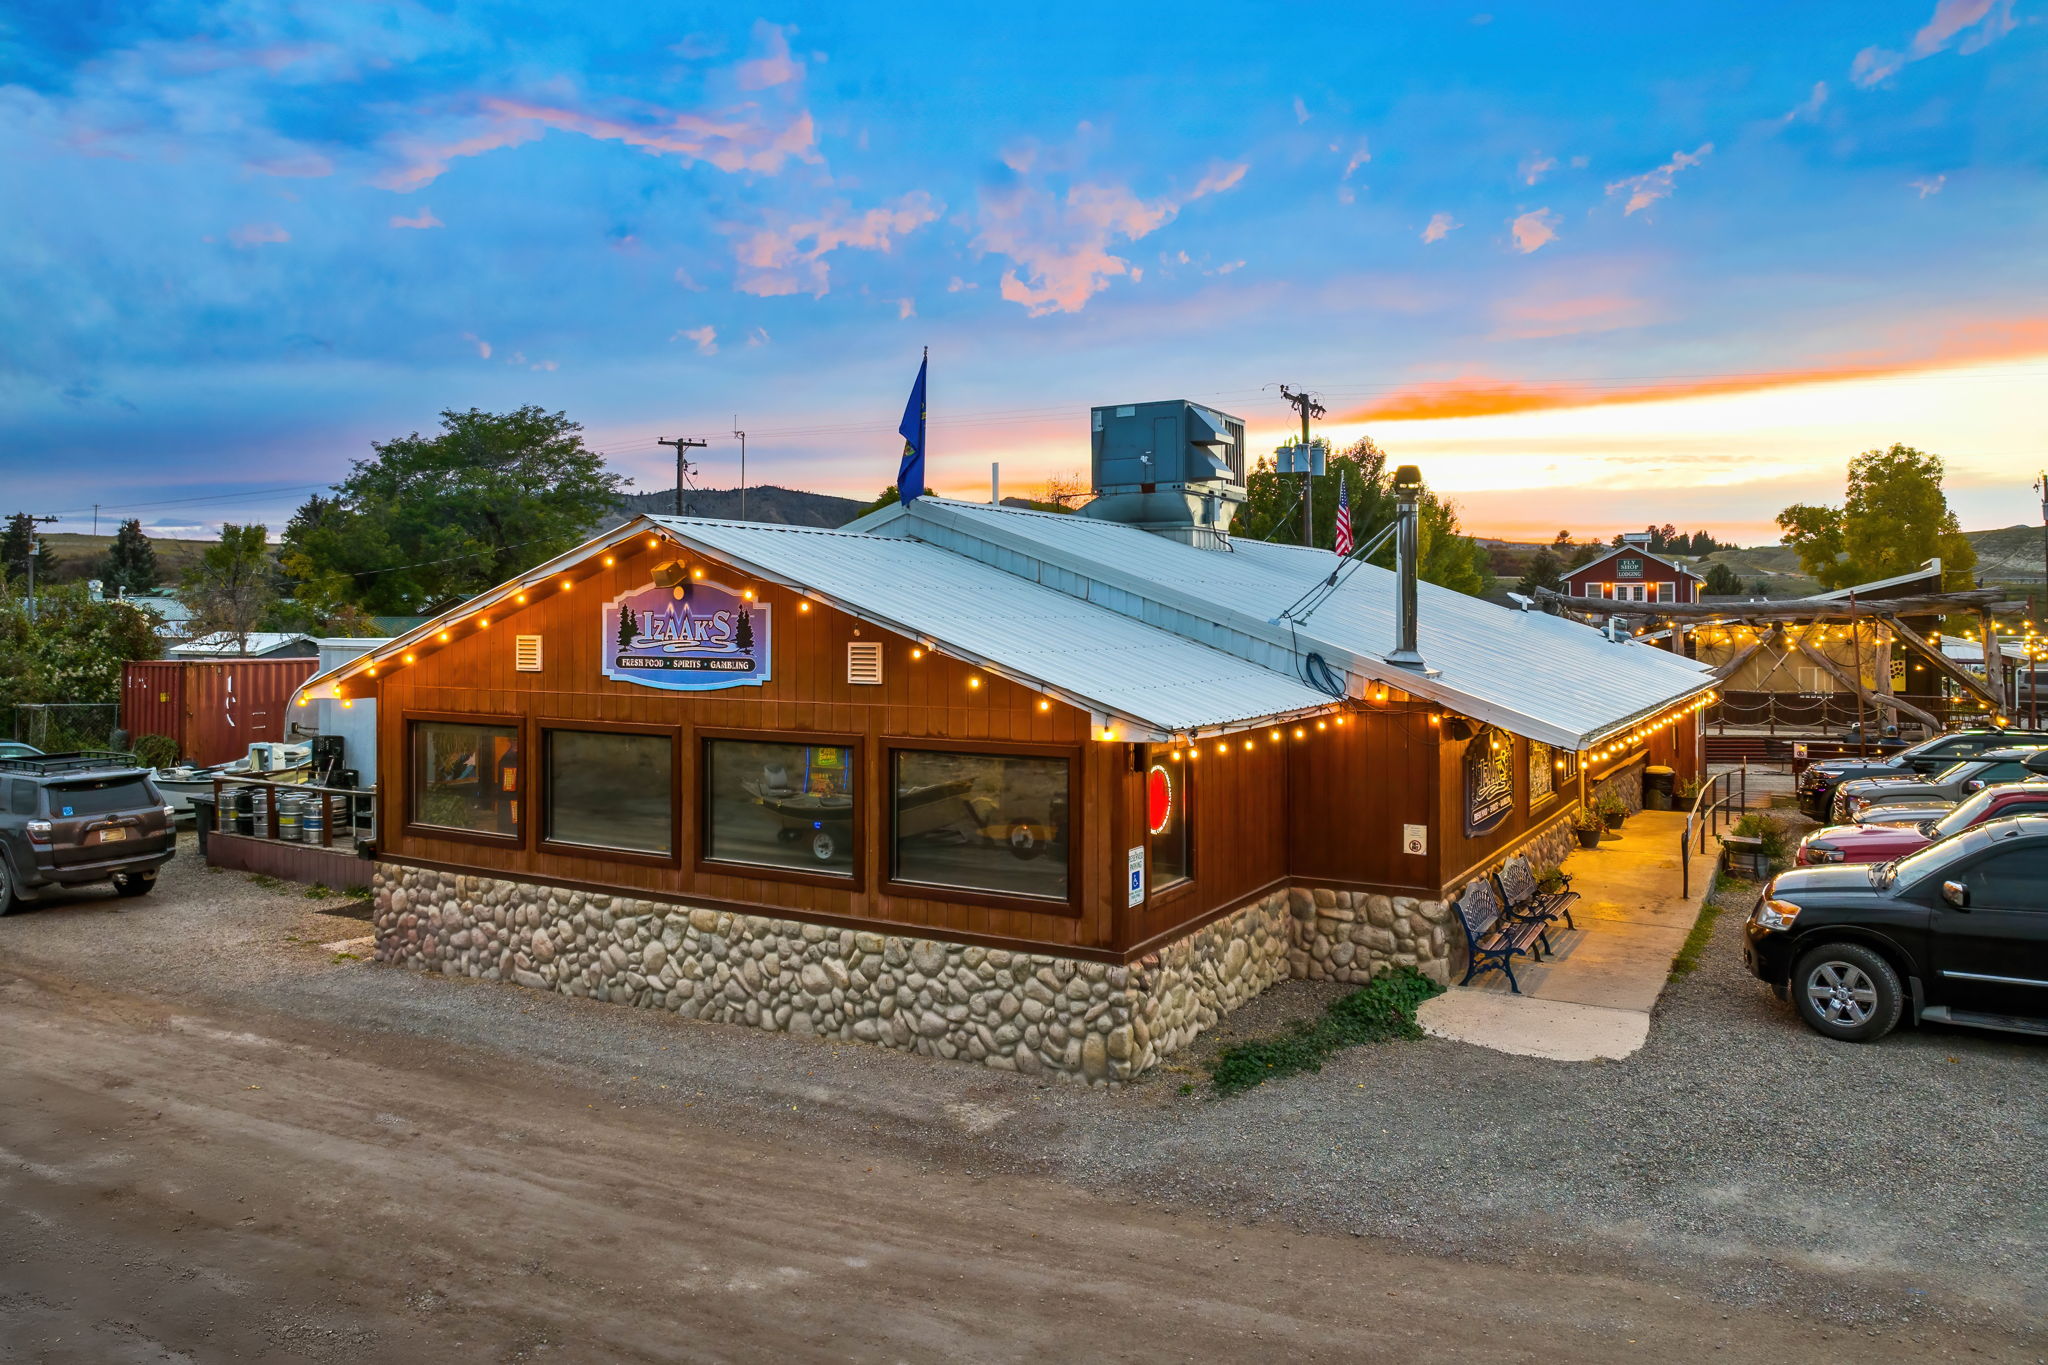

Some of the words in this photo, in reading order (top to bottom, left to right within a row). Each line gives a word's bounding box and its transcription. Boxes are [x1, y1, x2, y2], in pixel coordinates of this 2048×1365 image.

[622, 658, 643, 667] FRESH
[645, 659, 664, 668] FOOD
[673, 660, 701, 669] SPIRITS
[710, 661, 749, 670] GAMBLING
